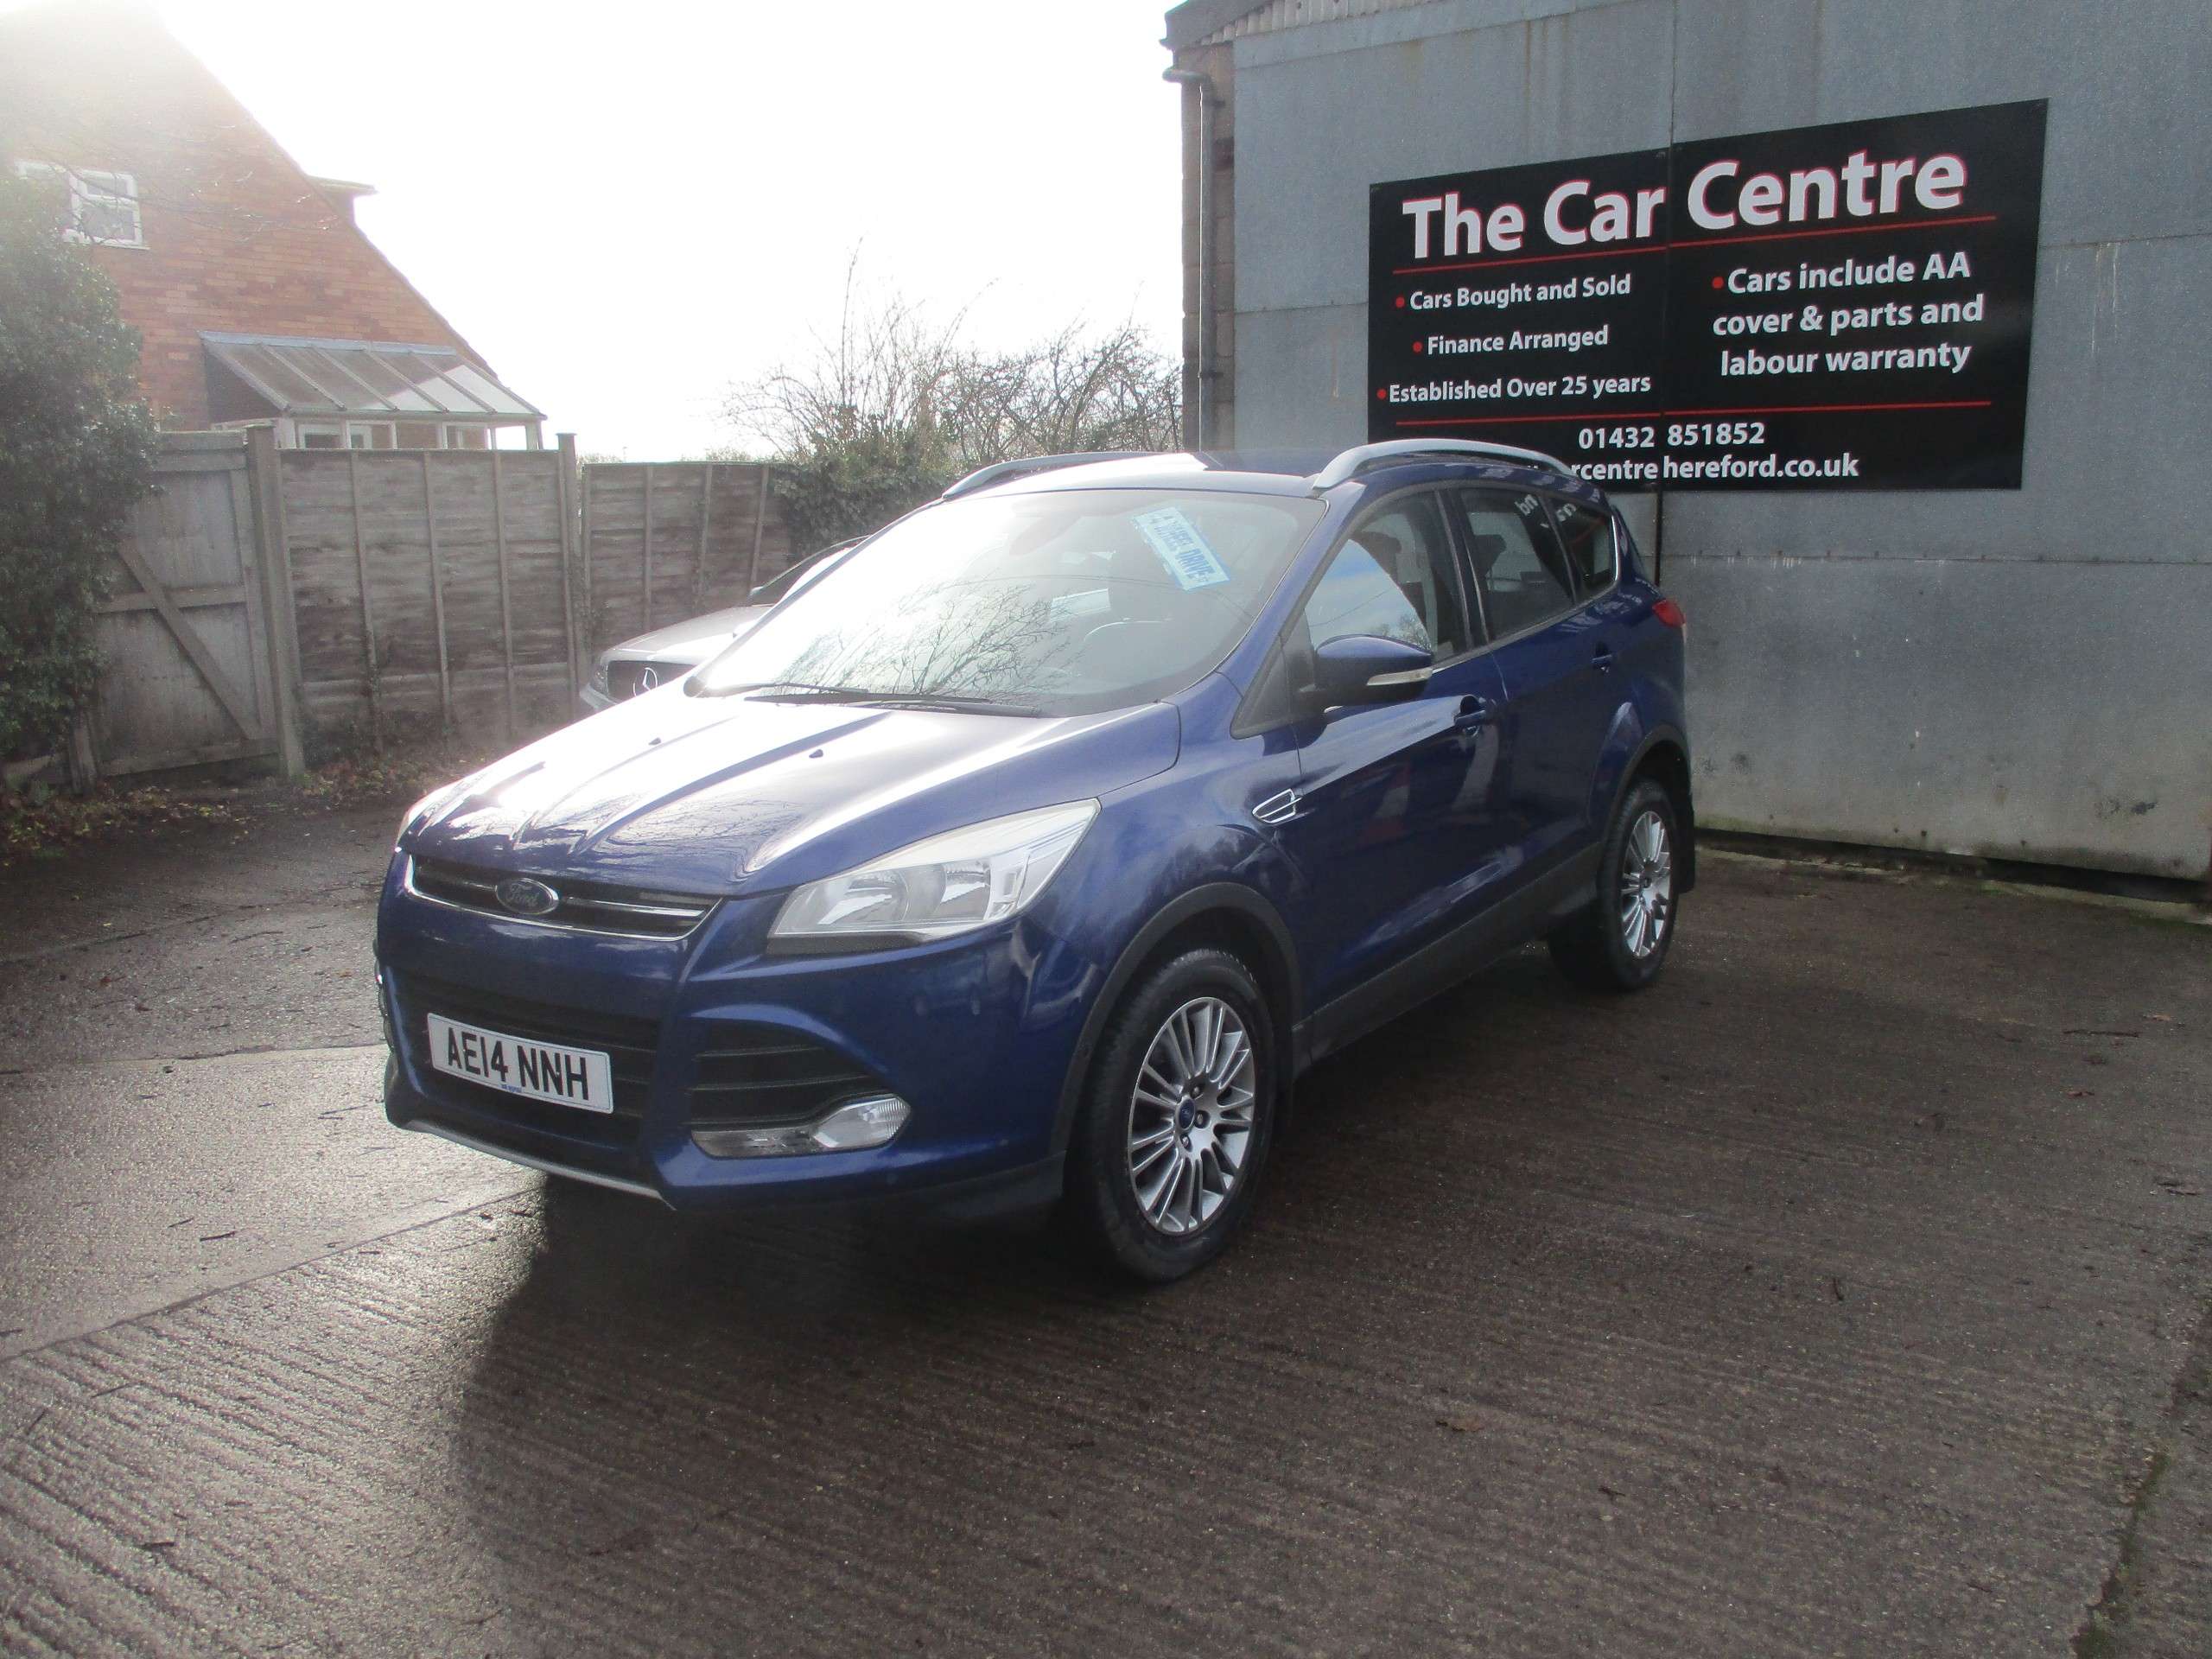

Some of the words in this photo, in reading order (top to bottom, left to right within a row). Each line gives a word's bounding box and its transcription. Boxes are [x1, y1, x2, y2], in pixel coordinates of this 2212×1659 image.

[1402, 192, 1524, 258] The
[1544, 180, 1665, 245] Car
[1688, 150, 1967, 229] Centre
[1728, 269, 1790, 293] Cars
[1800, 256, 1915, 289] include
[1923, 252, 1970, 280] AA
[1410, 291, 1452, 309] Cars
[1458, 283, 1531, 308] Bought
[1537, 278, 1576, 301] and
[1583, 274, 1630, 296] Sold
[1713, 314, 1793, 335] cover
[1800, 306, 1823, 331] &
[1831, 302, 1912, 335] parts
[1921, 294, 1983, 324] and
[1428, 335, 1503, 354] Finance
[1510, 325, 1608, 352] Arranged
[1722, 349, 1818, 375] labour
[1826, 343, 1971, 373] warranty
[1390, 378, 1501, 402] Established
[1507, 378, 1556, 397] Over
[1561, 376, 1586, 394] 25
[1593, 378, 1650, 398] years
[1579, 427, 1654, 448] 01432
[1668, 423, 1764, 445] 851852
[1174, 548, 1217, 580] DRIVE
[448, 1027, 509, 1082] AE14
[517, 1045, 589, 1101] NNH
